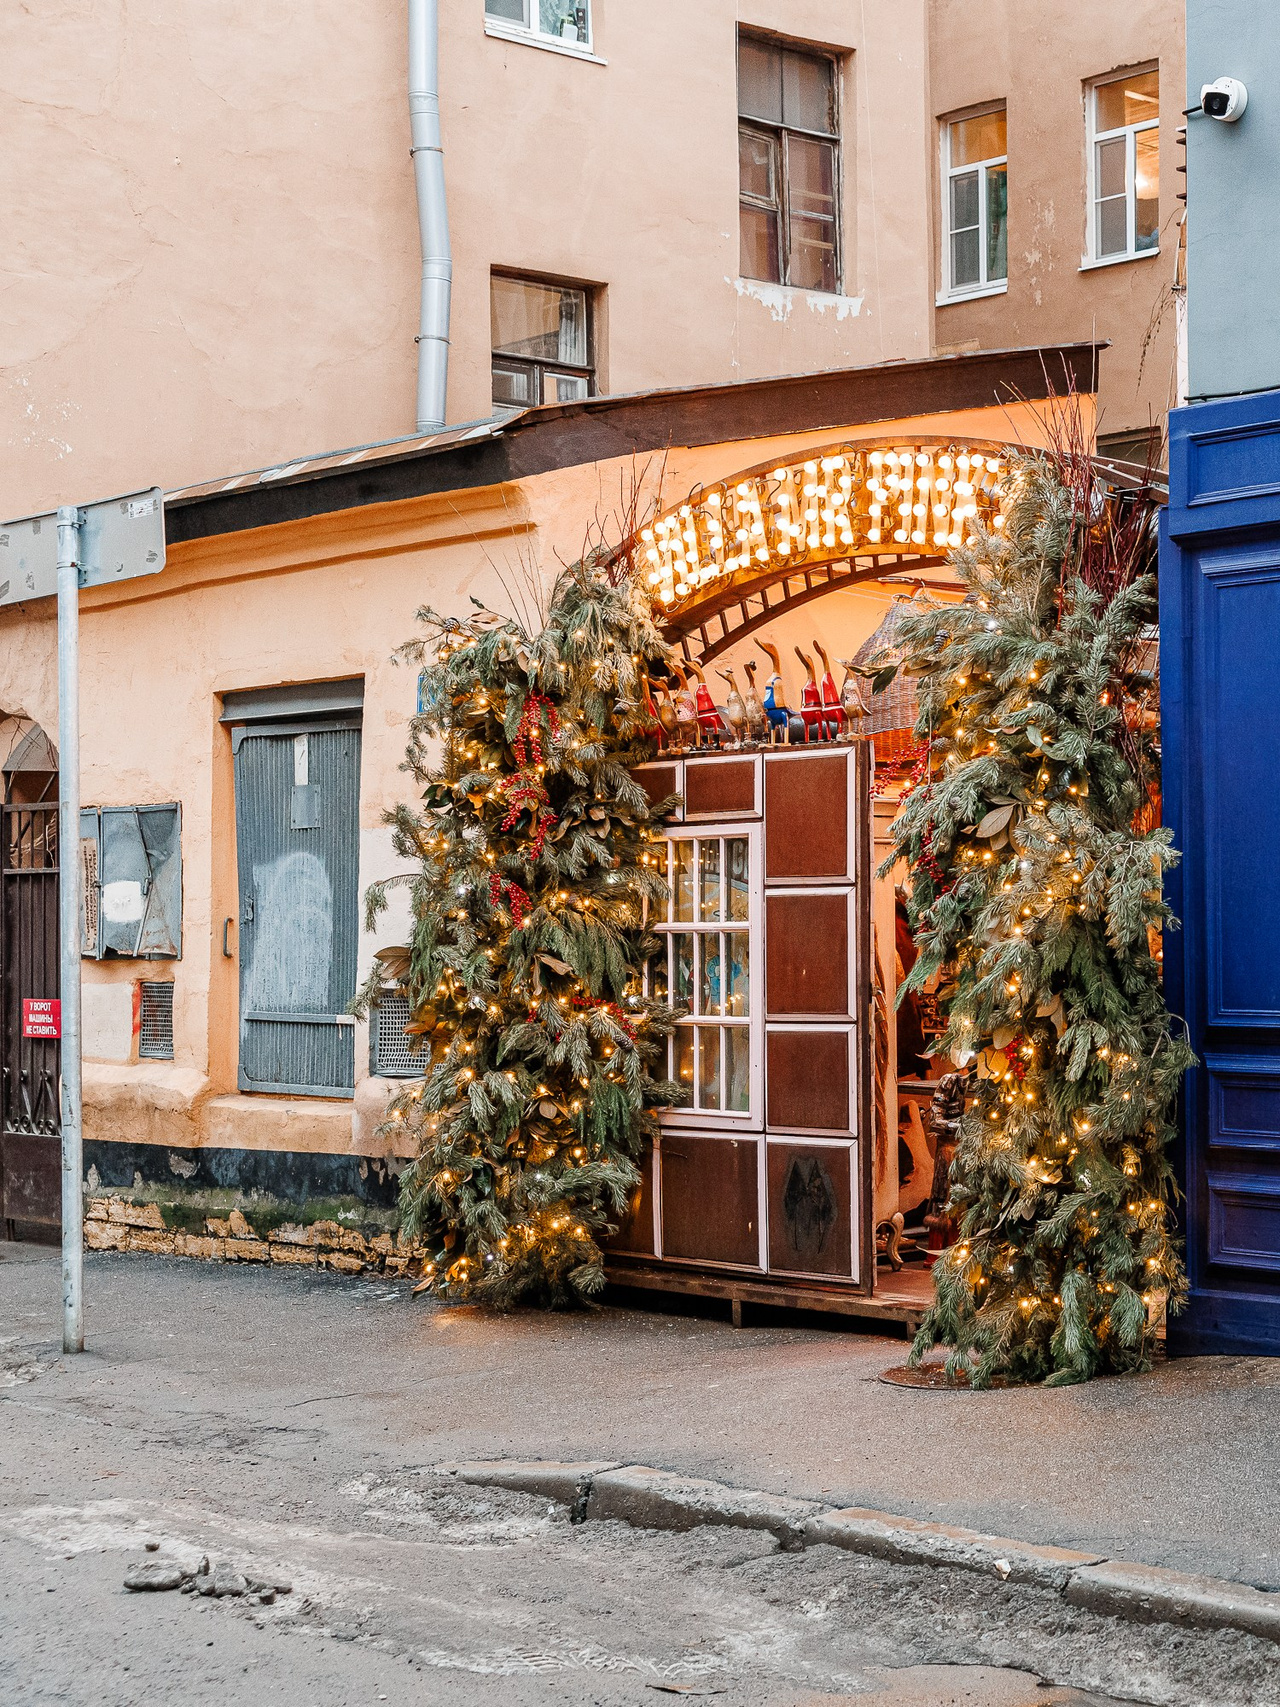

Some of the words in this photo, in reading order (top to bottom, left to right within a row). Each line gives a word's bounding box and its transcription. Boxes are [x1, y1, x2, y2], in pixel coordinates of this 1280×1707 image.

[29, 1002, 34, 1011] У
[33, 1002, 52, 1012] ВОРОТ
[28, 1013, 53, 1024] МАШИНЫ
[25, 1025, 33, 1035] НЕ
[32, 1025, 58, 1036] СТАВИТЬ
